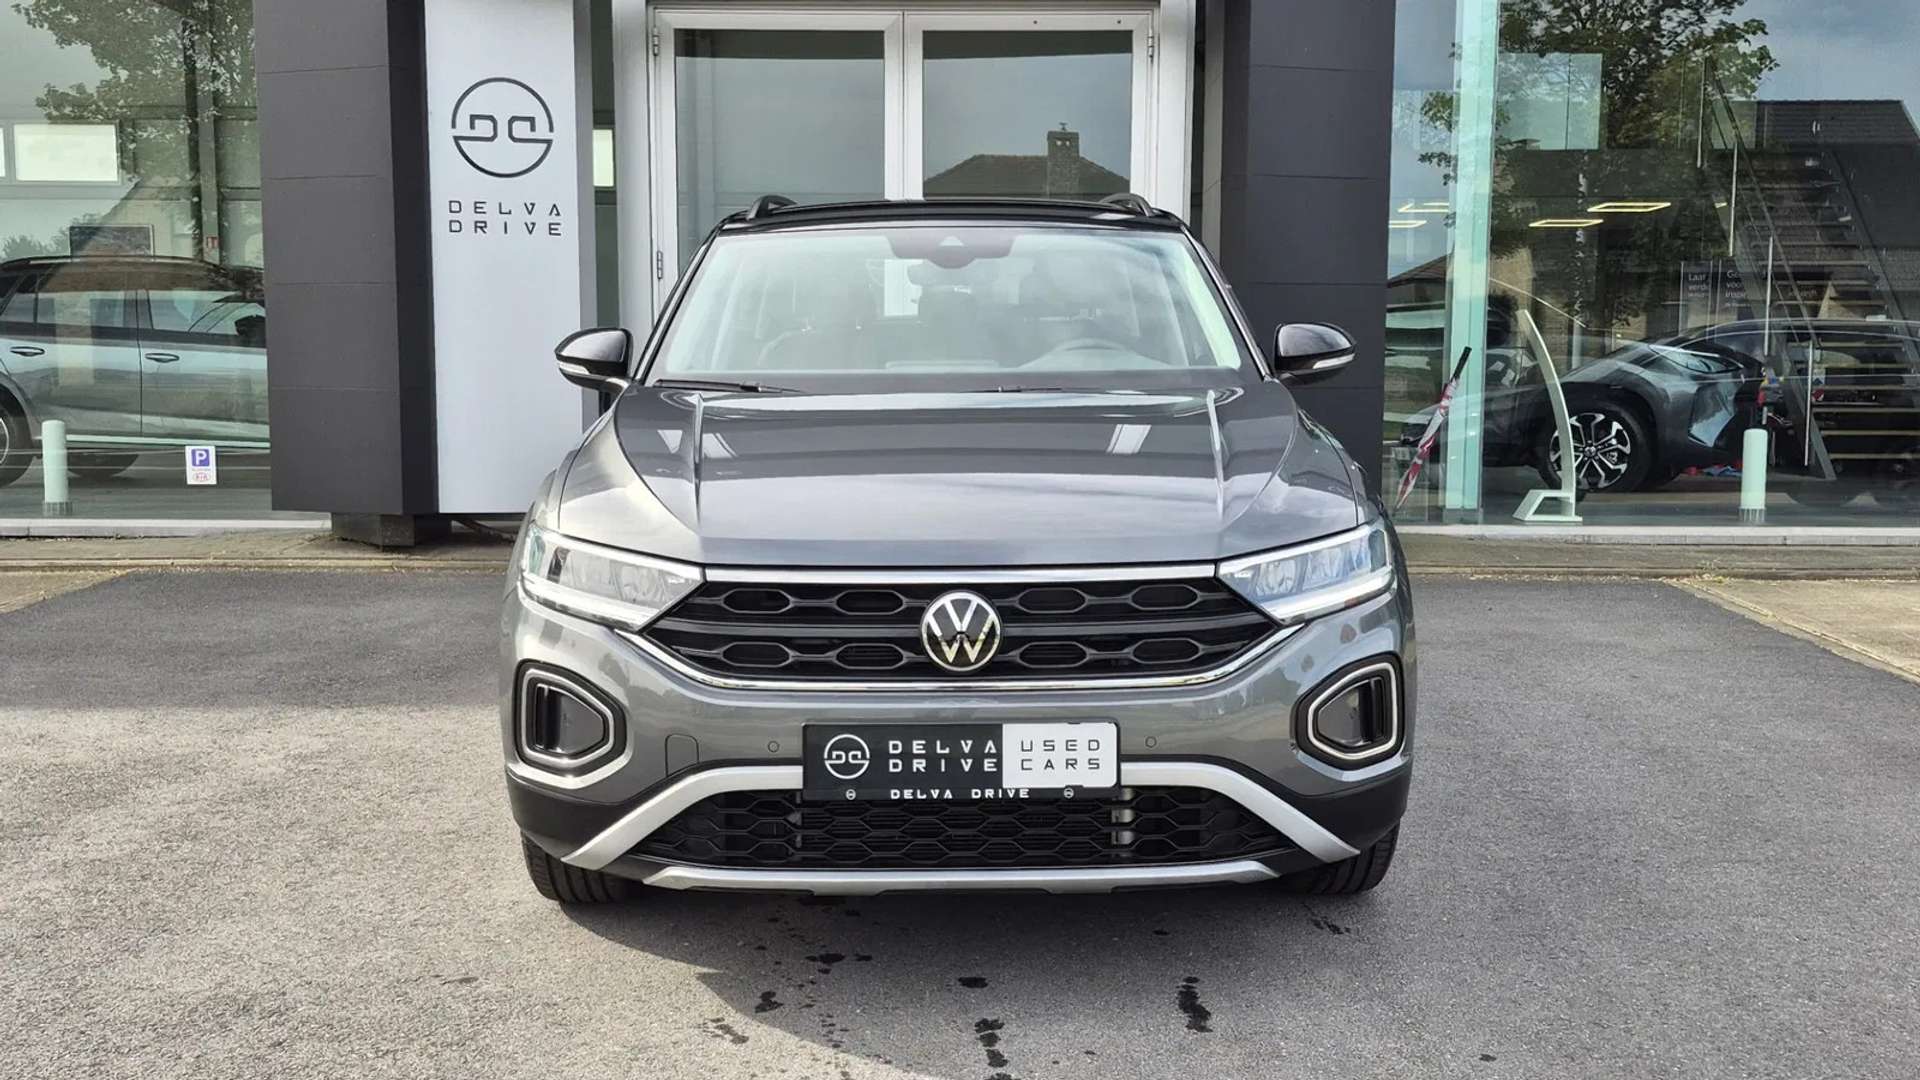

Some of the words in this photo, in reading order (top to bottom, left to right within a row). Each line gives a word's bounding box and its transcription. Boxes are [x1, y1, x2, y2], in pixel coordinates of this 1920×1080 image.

[449, 200, 561, 216] DELVA
[449, 220, 561, 236] DRIVE
[195, 450, 207, 466] P
[888, 740, 997, 754] DELVA
[1021, 739, 1100, 752] USED
[888, 758, 997, 772] DRIVE
[1021, 758, 1100, 771] CARS
[890, 788, 953, 799] DELVA
[971, 788, 1030, 799] DRIVE
